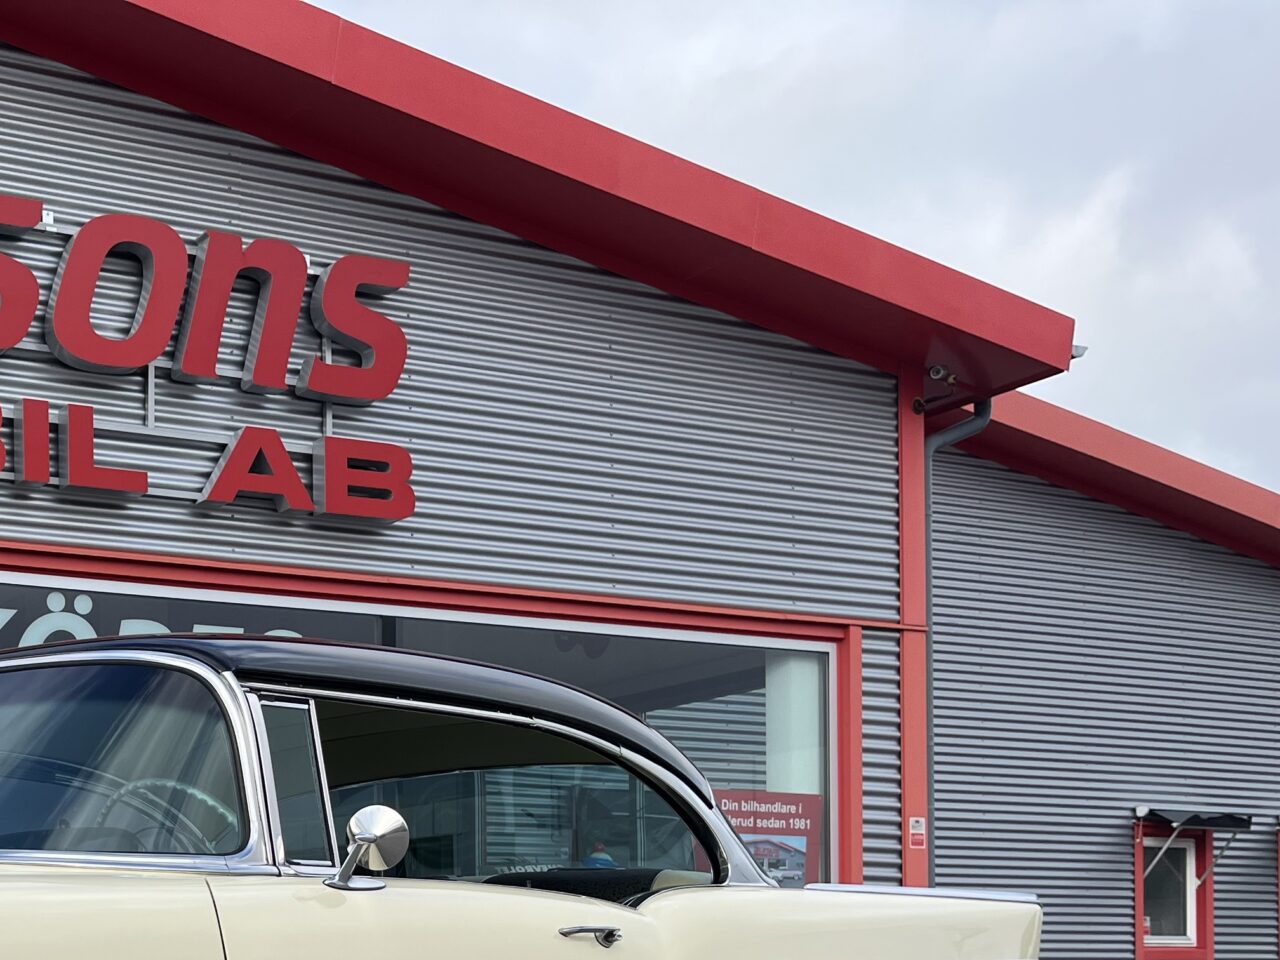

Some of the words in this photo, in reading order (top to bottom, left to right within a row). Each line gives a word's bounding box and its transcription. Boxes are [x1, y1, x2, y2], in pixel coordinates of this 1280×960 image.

[200, 426, 415, 521] AB
[721, 799, 739, 811] Din
[741, 800, 797, 814] bilhandlare
[798, 802, 802, 815] i
[728, 815, 754, 827] lerud
[756, 817, 786, 829] sedan
[789, 817, 811, 830] 1981
